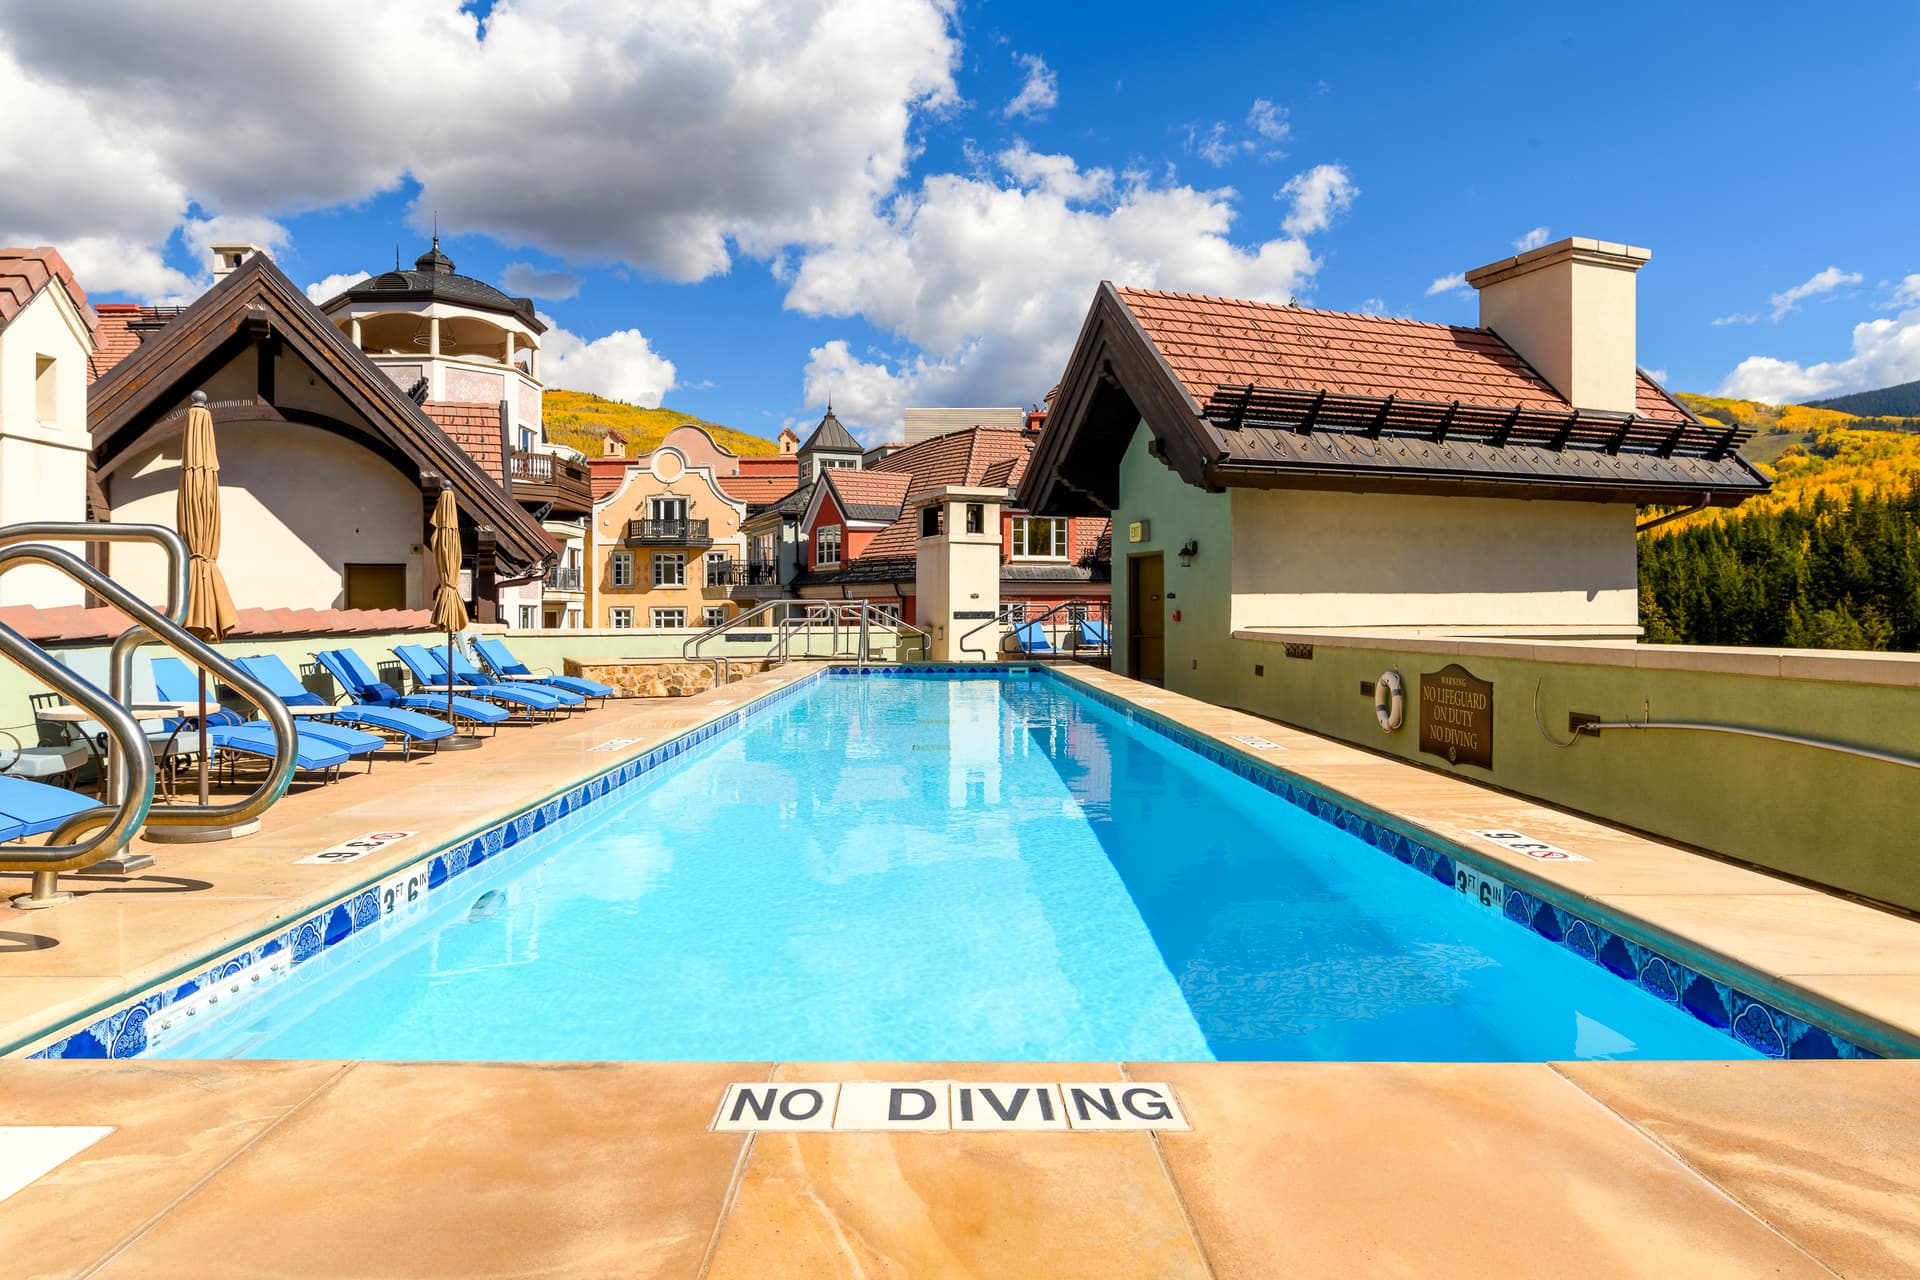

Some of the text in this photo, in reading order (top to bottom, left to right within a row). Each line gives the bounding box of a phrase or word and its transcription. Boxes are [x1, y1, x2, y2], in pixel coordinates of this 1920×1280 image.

[1423, 685, 1487, 710] NO LIFEGUARD
[1433, 705, 1474, 727] ON DUTY
[1430, 724, 1478, 750] NO DIVING
[729, 1087, 1174, 1122] NO DIVING
